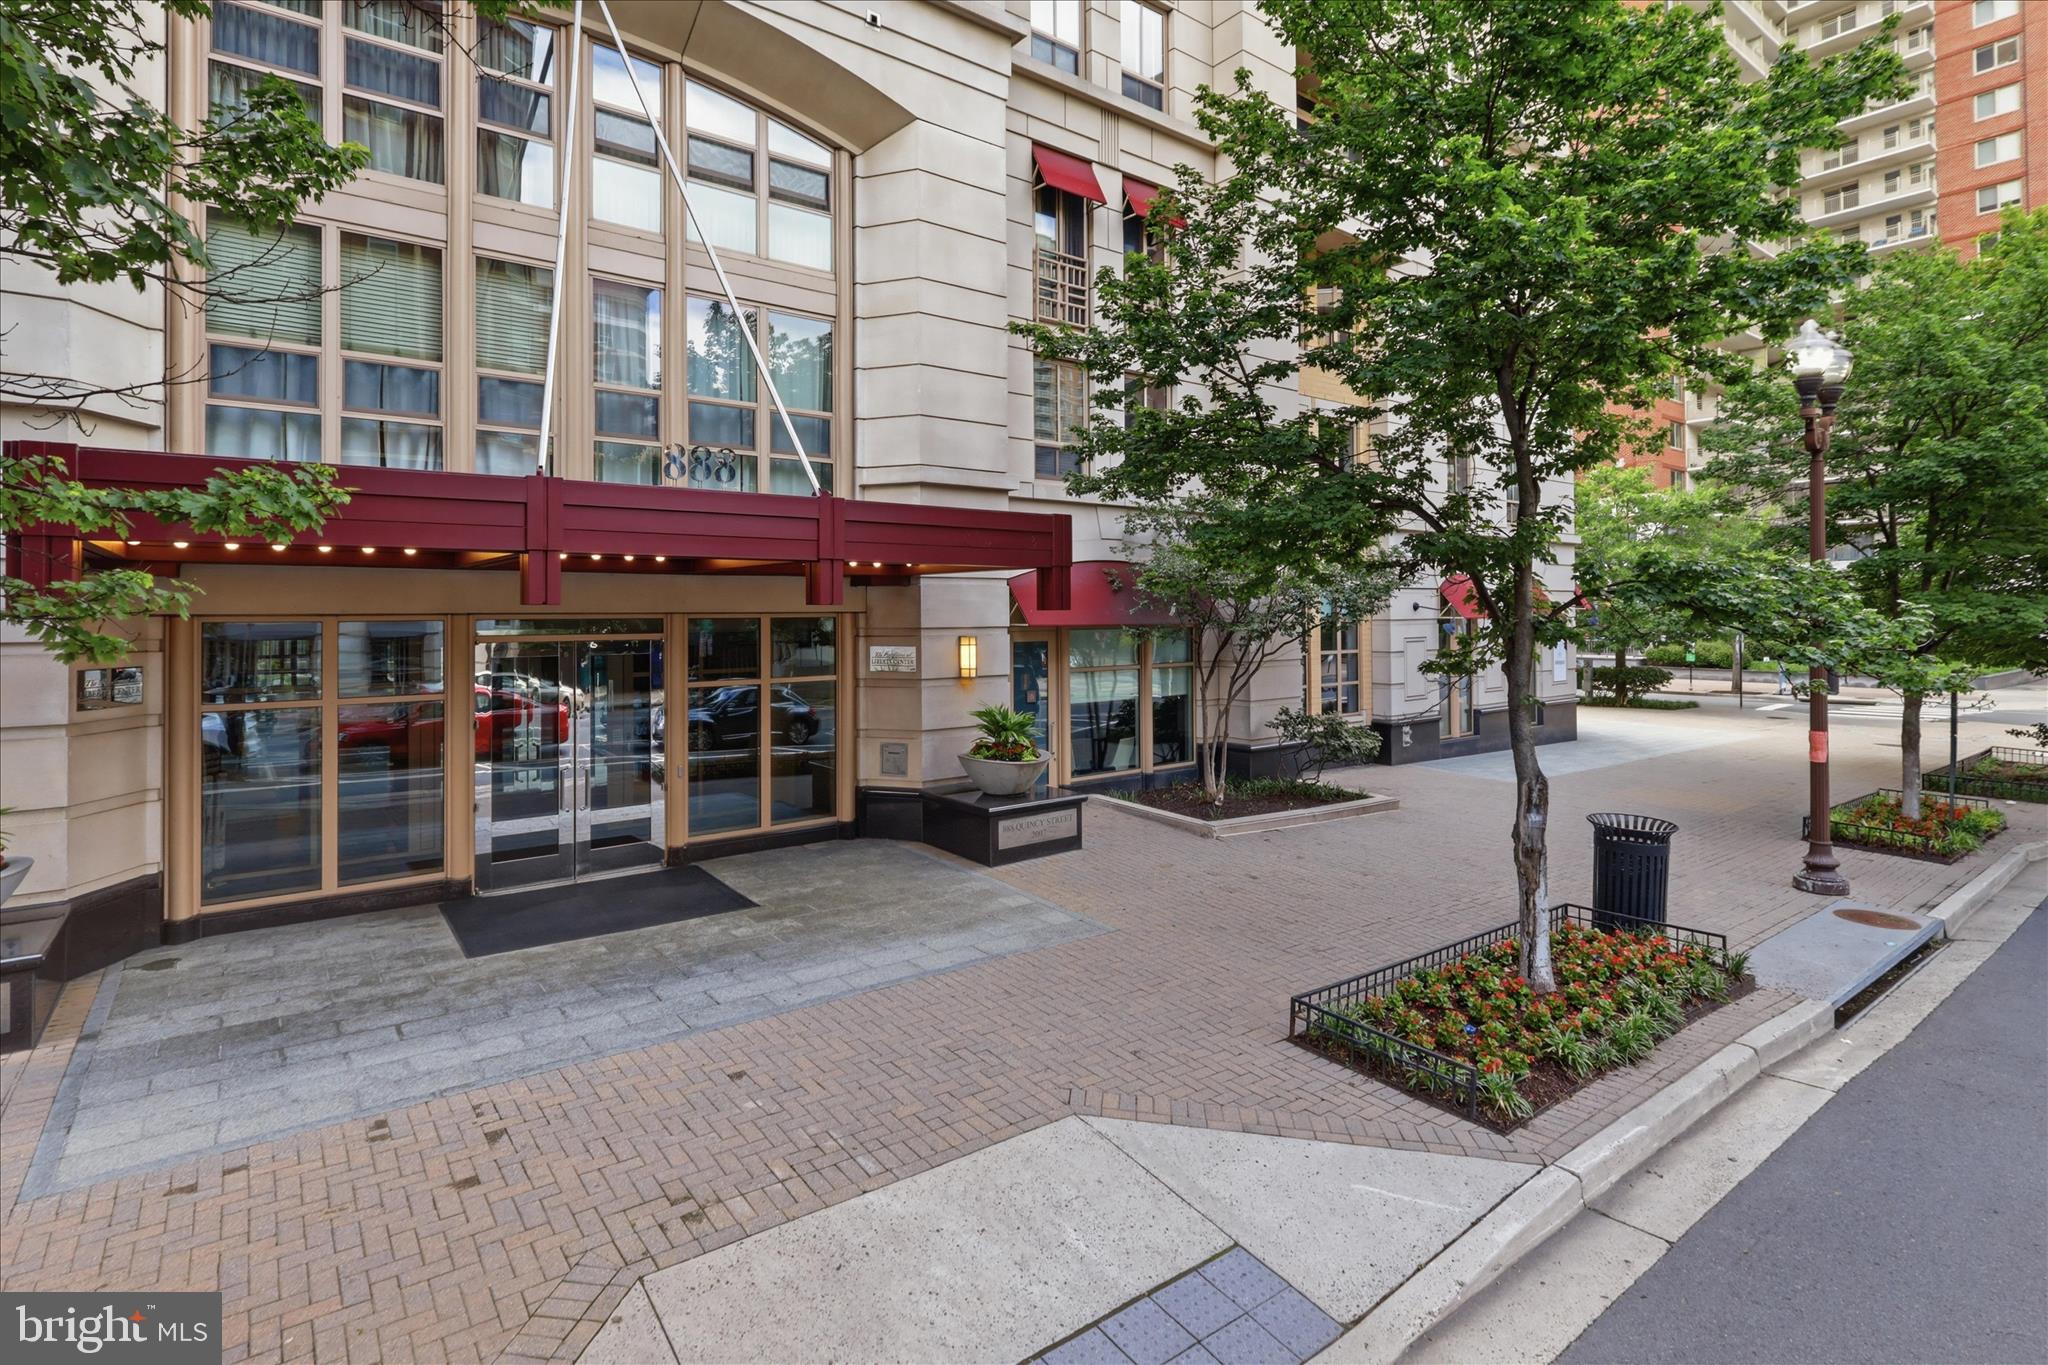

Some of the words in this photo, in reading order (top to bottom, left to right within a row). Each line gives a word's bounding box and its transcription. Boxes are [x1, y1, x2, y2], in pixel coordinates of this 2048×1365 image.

[664, 443, 736, 483] 888
[1015, 818, 1045, 832] QUINCY
[1046, 814, 1073, 826] STREET
